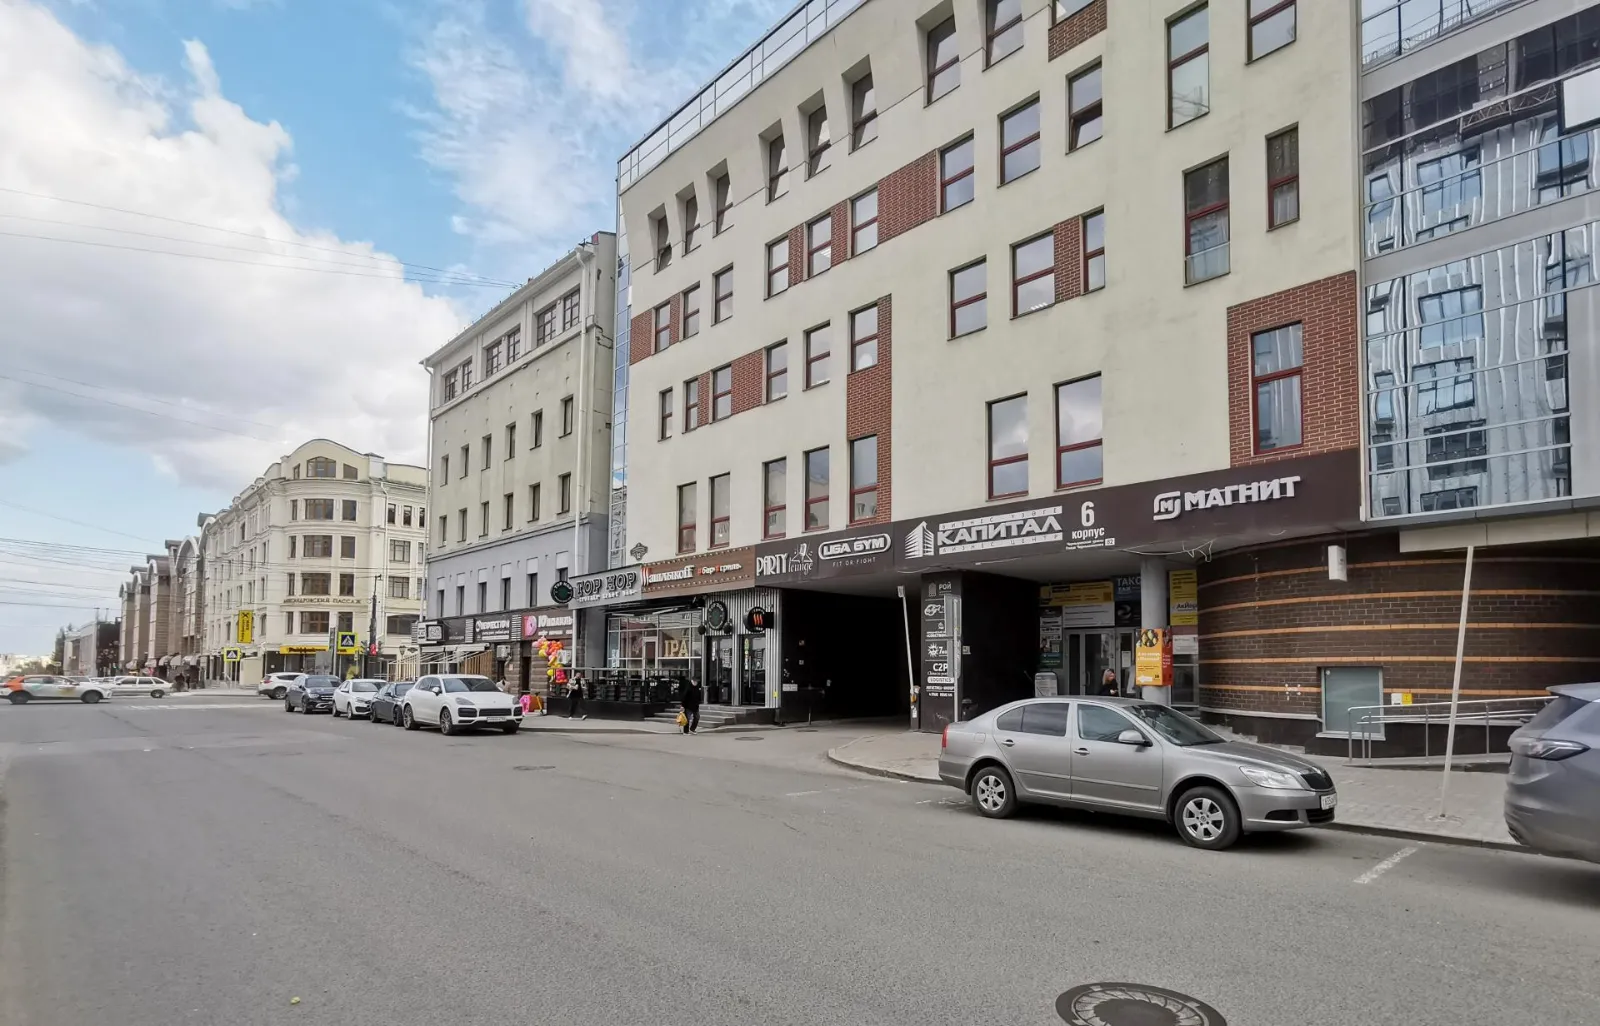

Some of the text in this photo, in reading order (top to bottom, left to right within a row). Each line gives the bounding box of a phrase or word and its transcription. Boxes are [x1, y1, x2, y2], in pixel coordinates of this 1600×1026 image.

[1184, 475, 1301, 511] МАГНИТ
[1081, 501, 1095, 527] 6
[937, 515, 1063, 546] КАПИТАЛ
[1071, 526, 1105, 540] корпус
[853, 537, 885, 551] GYM
[941, 540, 994, 553] БИЗНЕС
[756, 553, 788, 576] PARTY
[856, 557, 876, 565] FIGHT
[576, 571, 637, 597] TOP HOP
[938, 581, 952, 590] РОЙ
[664, 639, 689, 658] IPA
